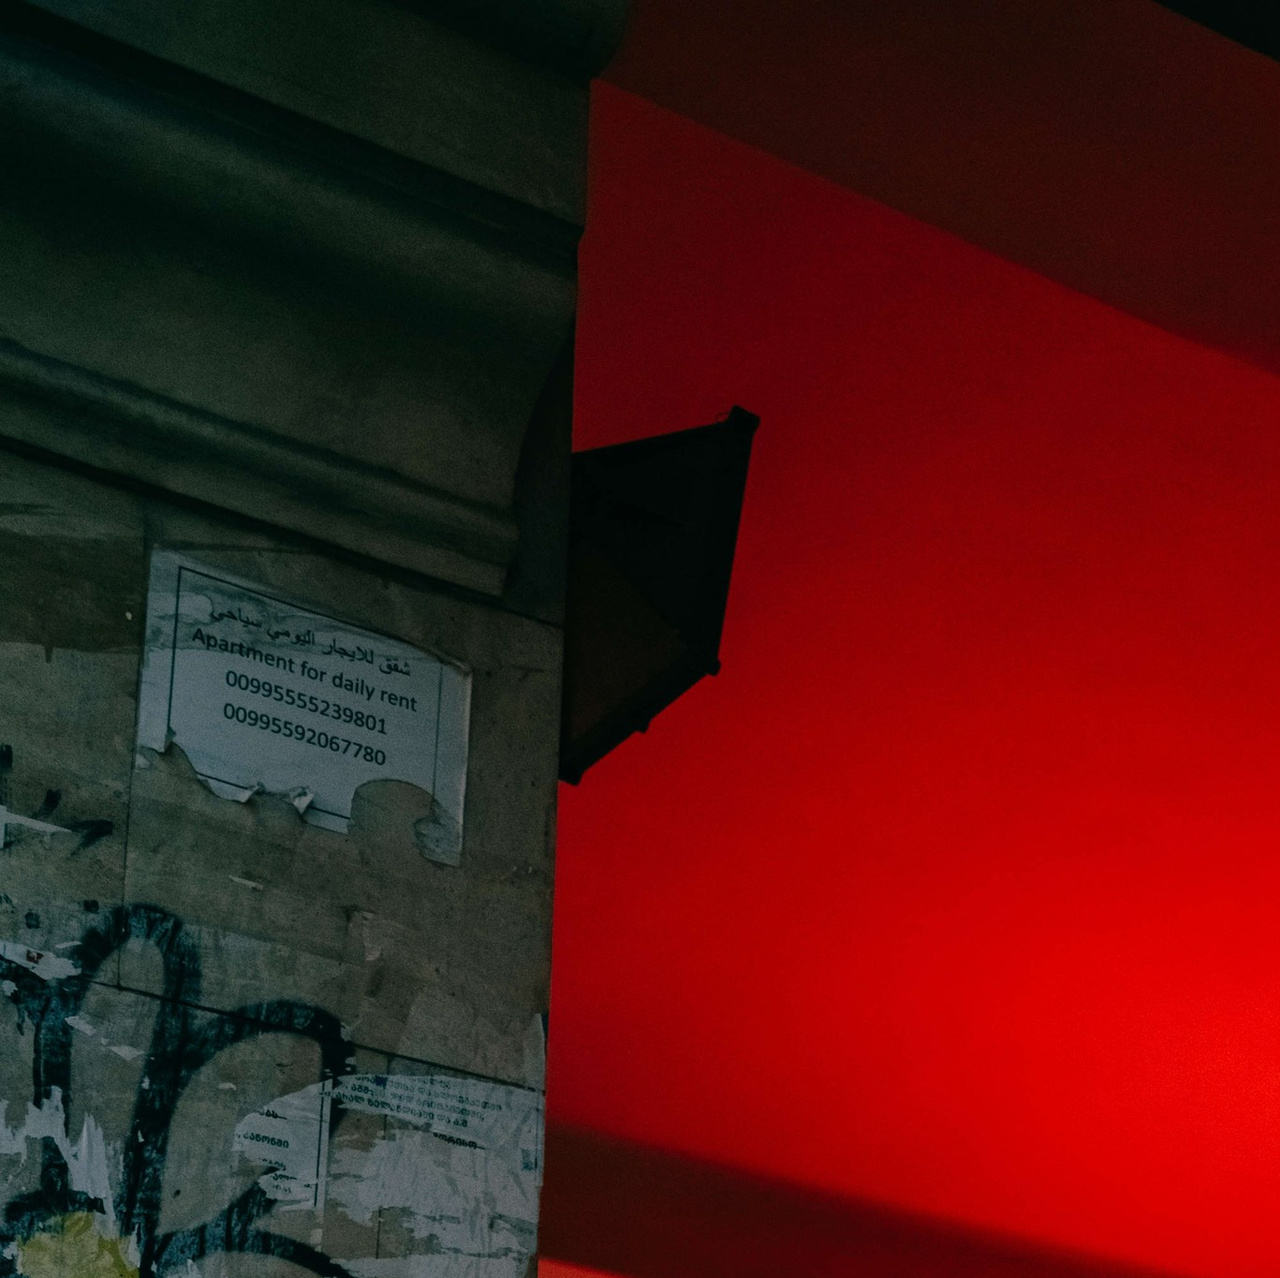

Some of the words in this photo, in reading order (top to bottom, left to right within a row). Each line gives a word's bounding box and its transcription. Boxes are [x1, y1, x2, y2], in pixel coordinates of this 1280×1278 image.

[192, 627, 296, 675] Apartment
[300, 661, 327, 684] for
[332, 672, 375, 702] daily
[380, 689, 418, 712] rent
[379, 658, 411, 677] شقق
[223, 702, 386, 766] 00995592067780
[225, 670, 387, 735] 00995555239801
